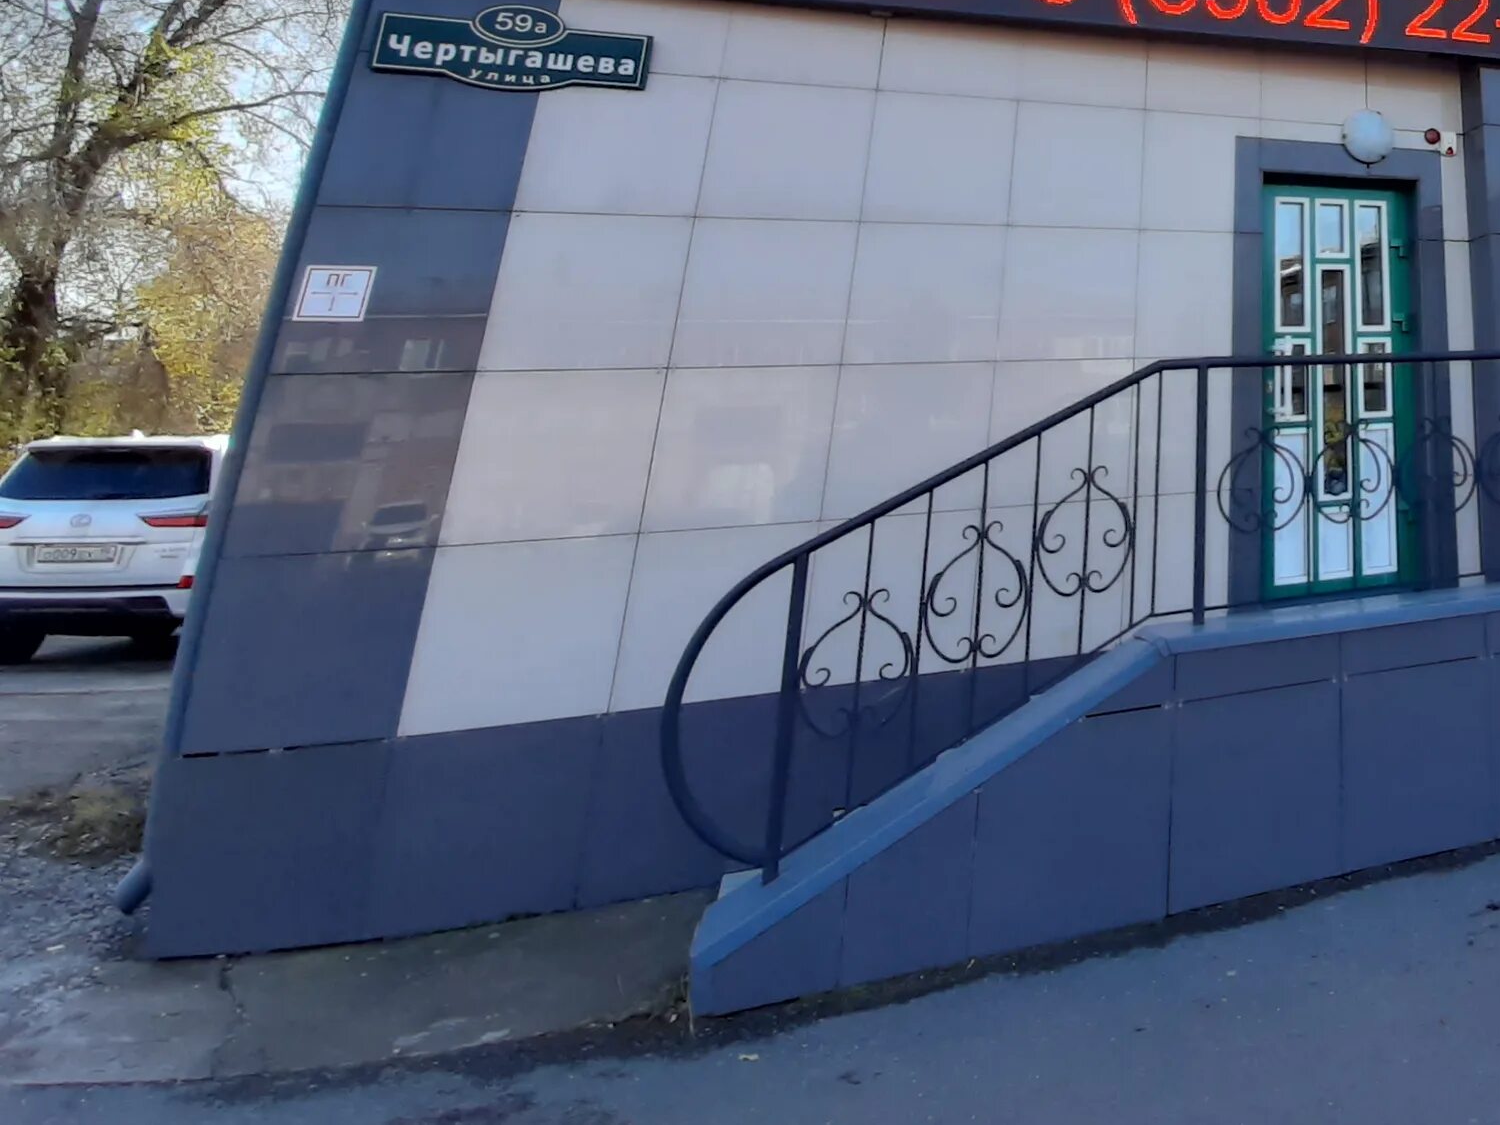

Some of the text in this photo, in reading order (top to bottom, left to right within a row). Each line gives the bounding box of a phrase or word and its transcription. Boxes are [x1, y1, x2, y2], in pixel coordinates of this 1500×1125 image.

[494, 12, 548, 35] 59а
[387, 33, 637, 77] Чертыгашева
[468, 67, 552, 85] улица
[325, 273, 353, 288] ПГ
